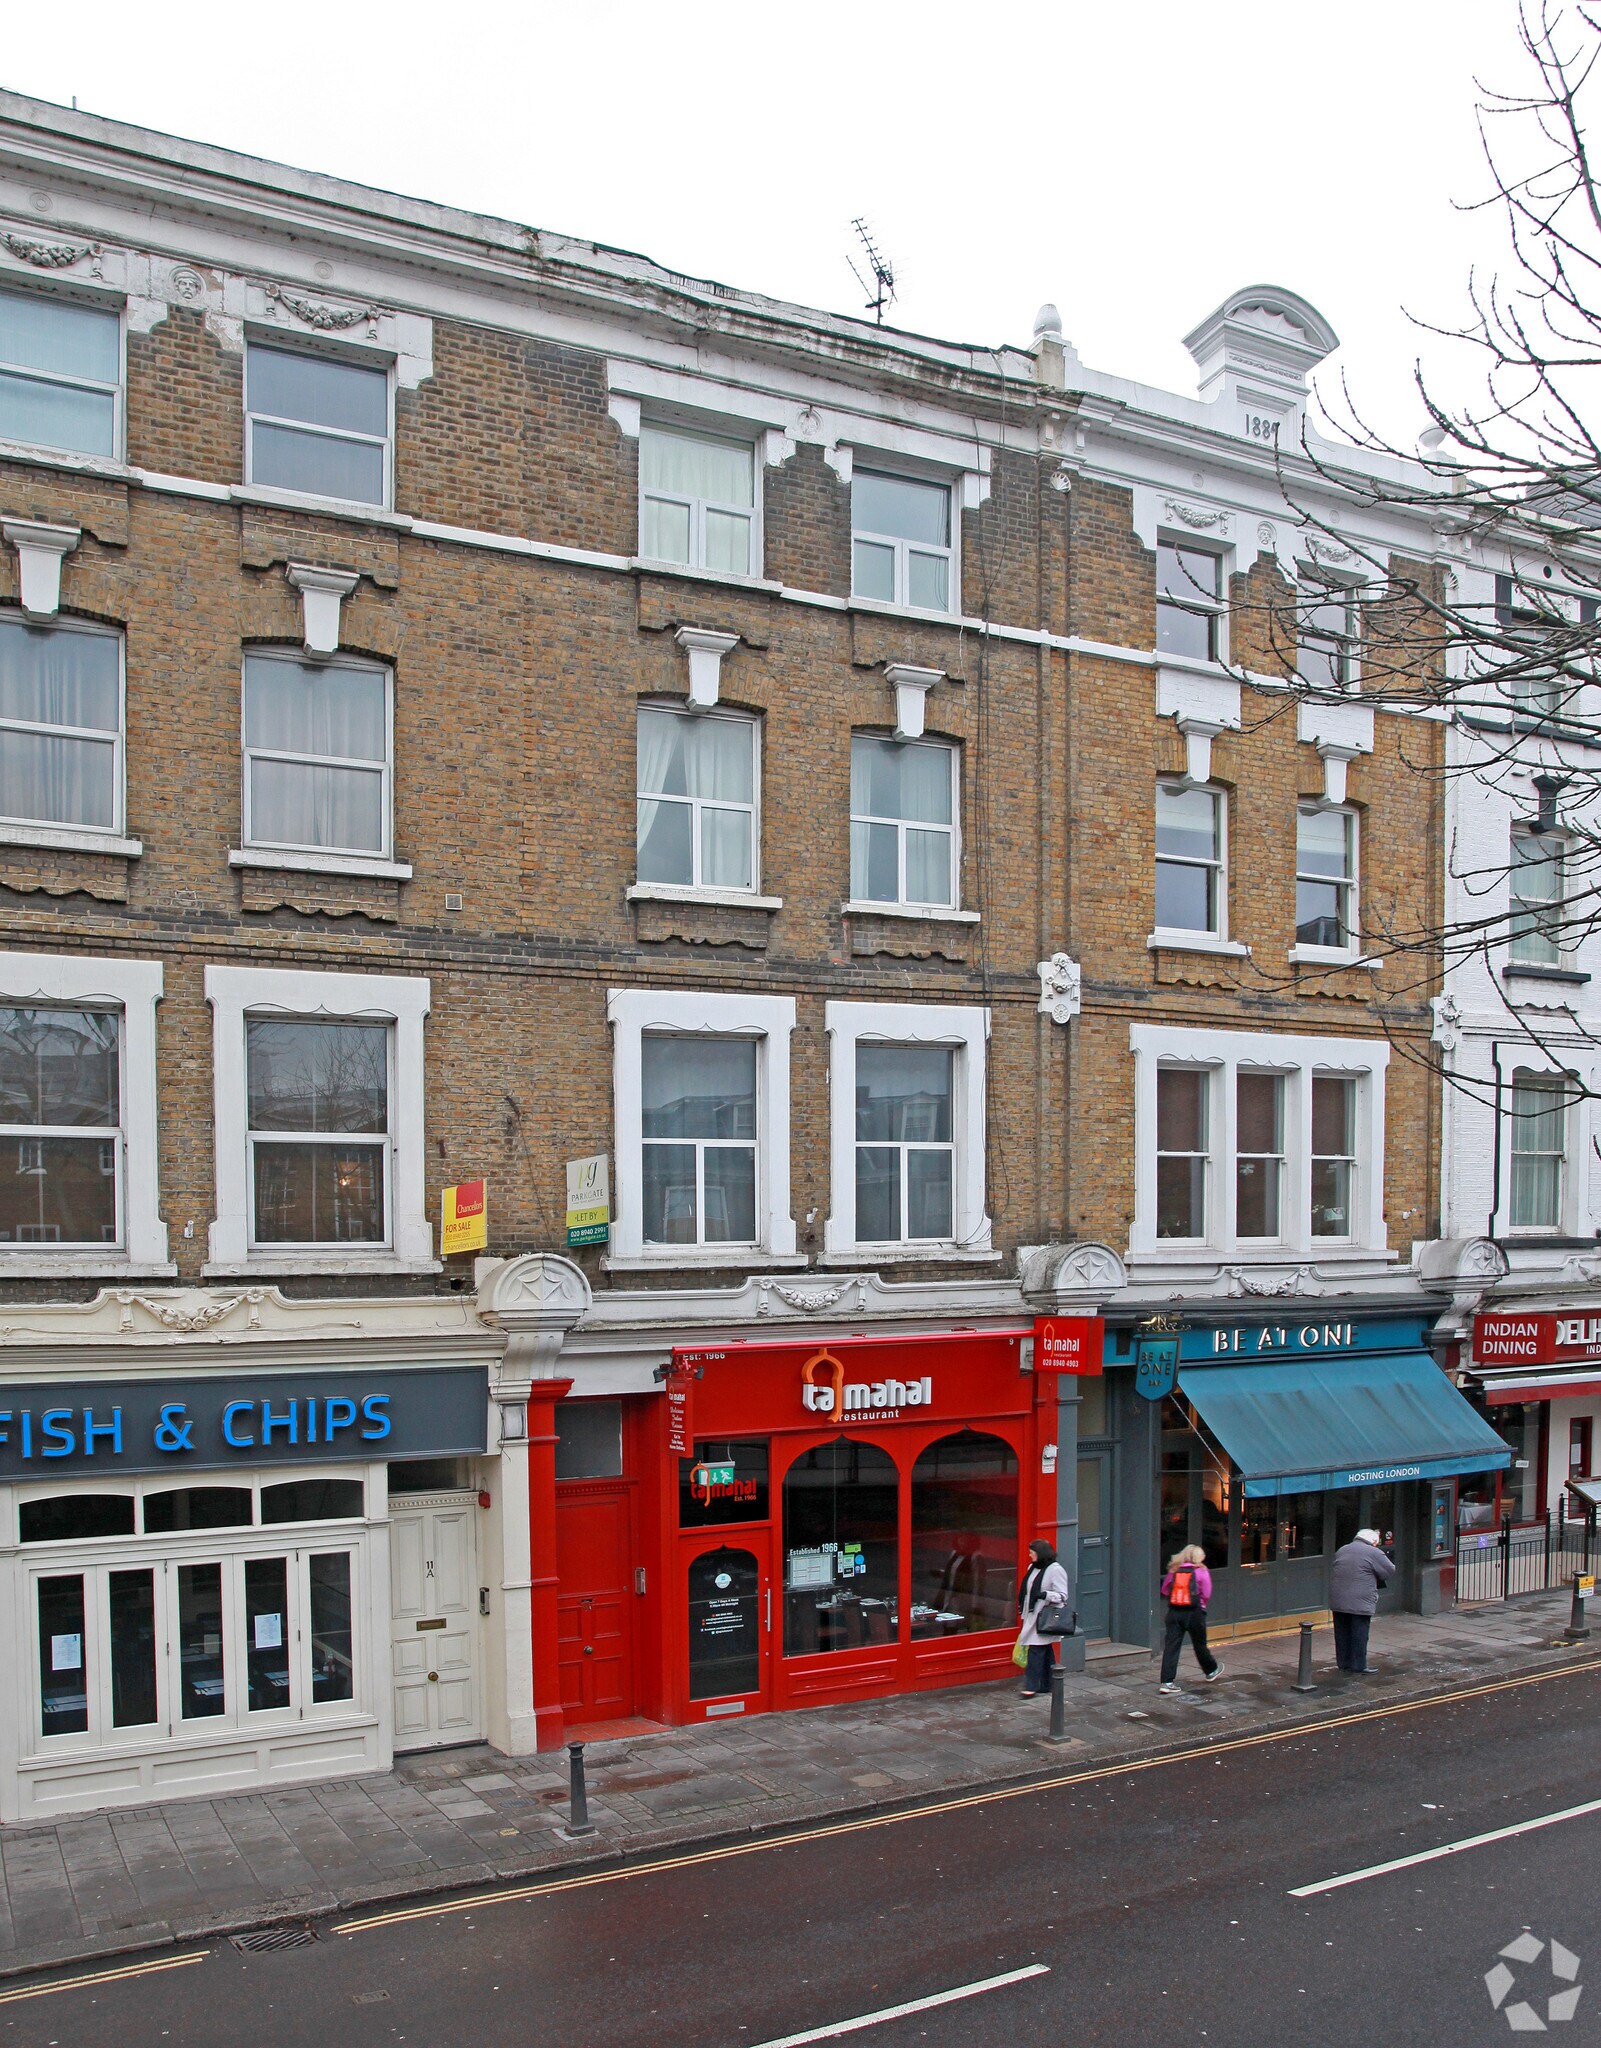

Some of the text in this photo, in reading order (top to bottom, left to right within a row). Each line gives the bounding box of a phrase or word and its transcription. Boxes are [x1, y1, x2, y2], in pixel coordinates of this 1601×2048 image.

[571, 1188, 604, 1202] PARKGATE
[457, 1200, 483, 1214] Chancellors
[576, 1211, 598, 1222] LET BY
[445, 1220, 471, 1234] FOR SALE
[1483, 1322, 1538, 1337] INDIAN
[1008, 1337, 1015, 1346] 9
[1214, 1323, 1359, 1353] BE AT ONE
[1482, 1340, 1537, 1355] DINING
[705, 1352, 726, 1360] 1966
[1042, 1358, 1052, 1366] 020
[1141, 1351, 1173, 1361] BE AT
[1140, 1363, 1171, 1375] ONE
[838, 1409, 900, 1422] restaurant
[154, 1402, 197, 1452] &
[221, 1393, 392, 1448] CHIPS
[1348, 1467, 1420, 1482] HOSTING LONDON
[789, 1546, 821, 1556] Established
[821, 1542, 839, 1553] 1966
[426, 1560, 434, 1570] 11
[426, 1569, 435, 1578] A
